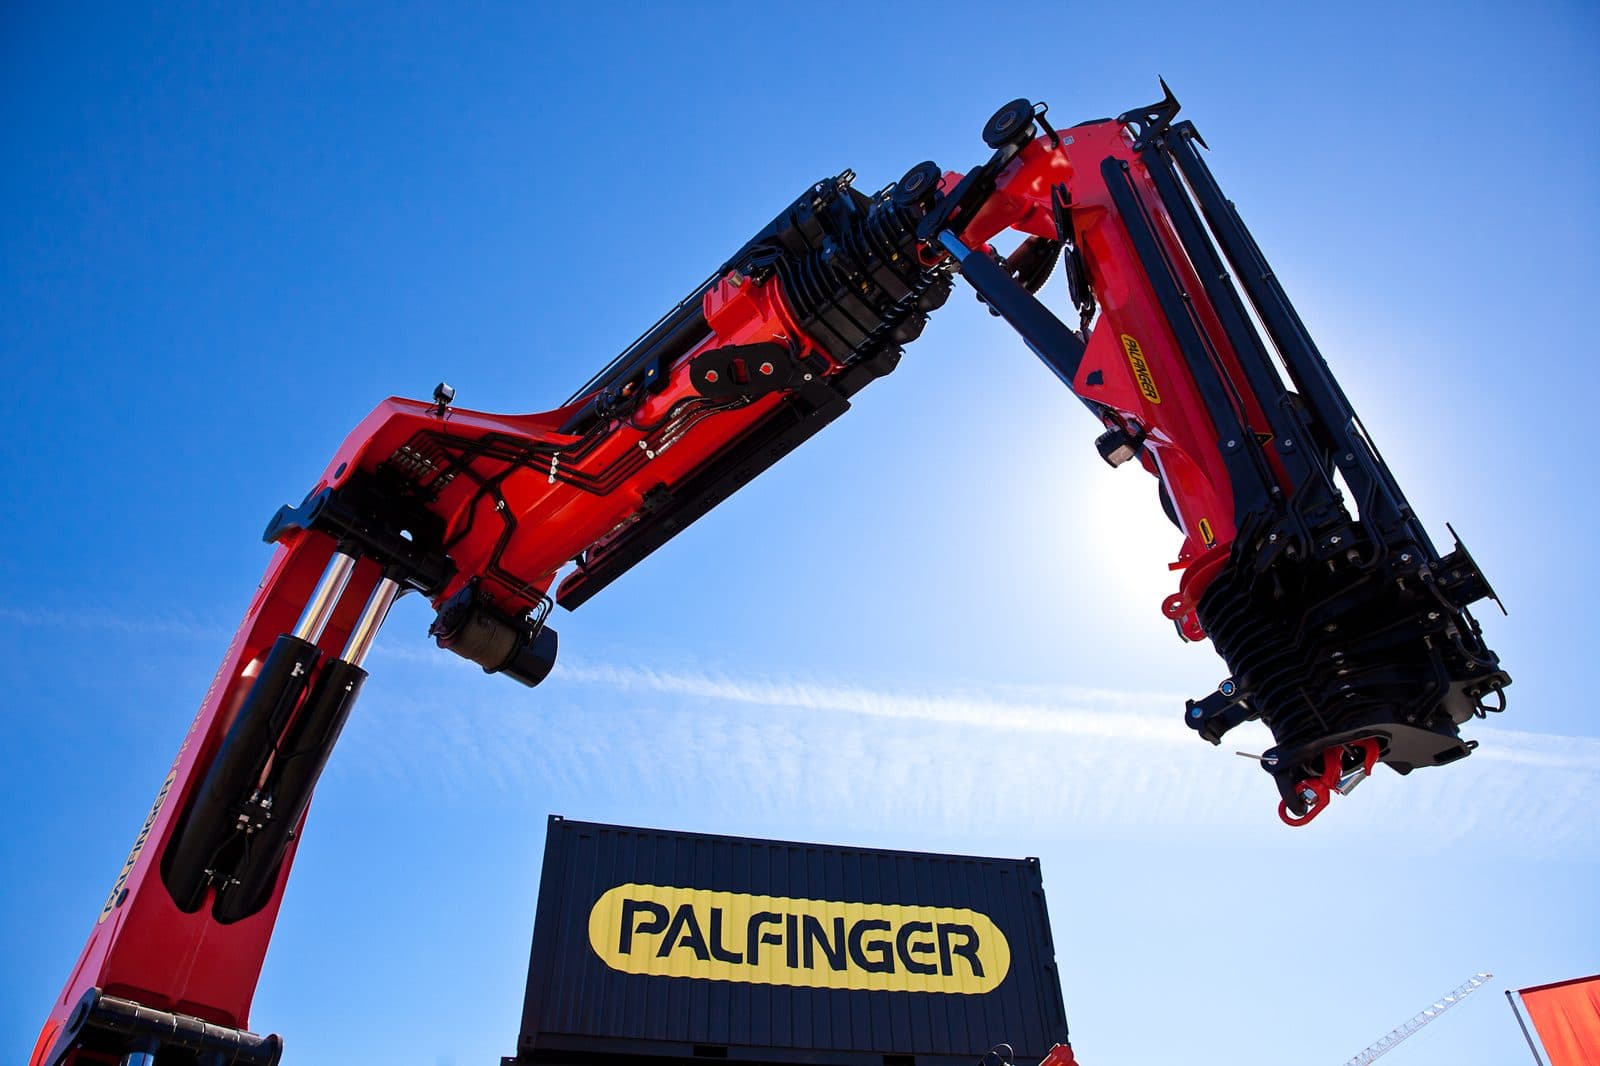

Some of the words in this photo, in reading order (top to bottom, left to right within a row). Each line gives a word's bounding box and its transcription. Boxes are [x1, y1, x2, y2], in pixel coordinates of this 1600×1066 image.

[1123, 336, 1159, 400] PALFINGER
[103, 777, 173, 913] PALFINGER
[618, 898, 985, 978] PALFINGER
